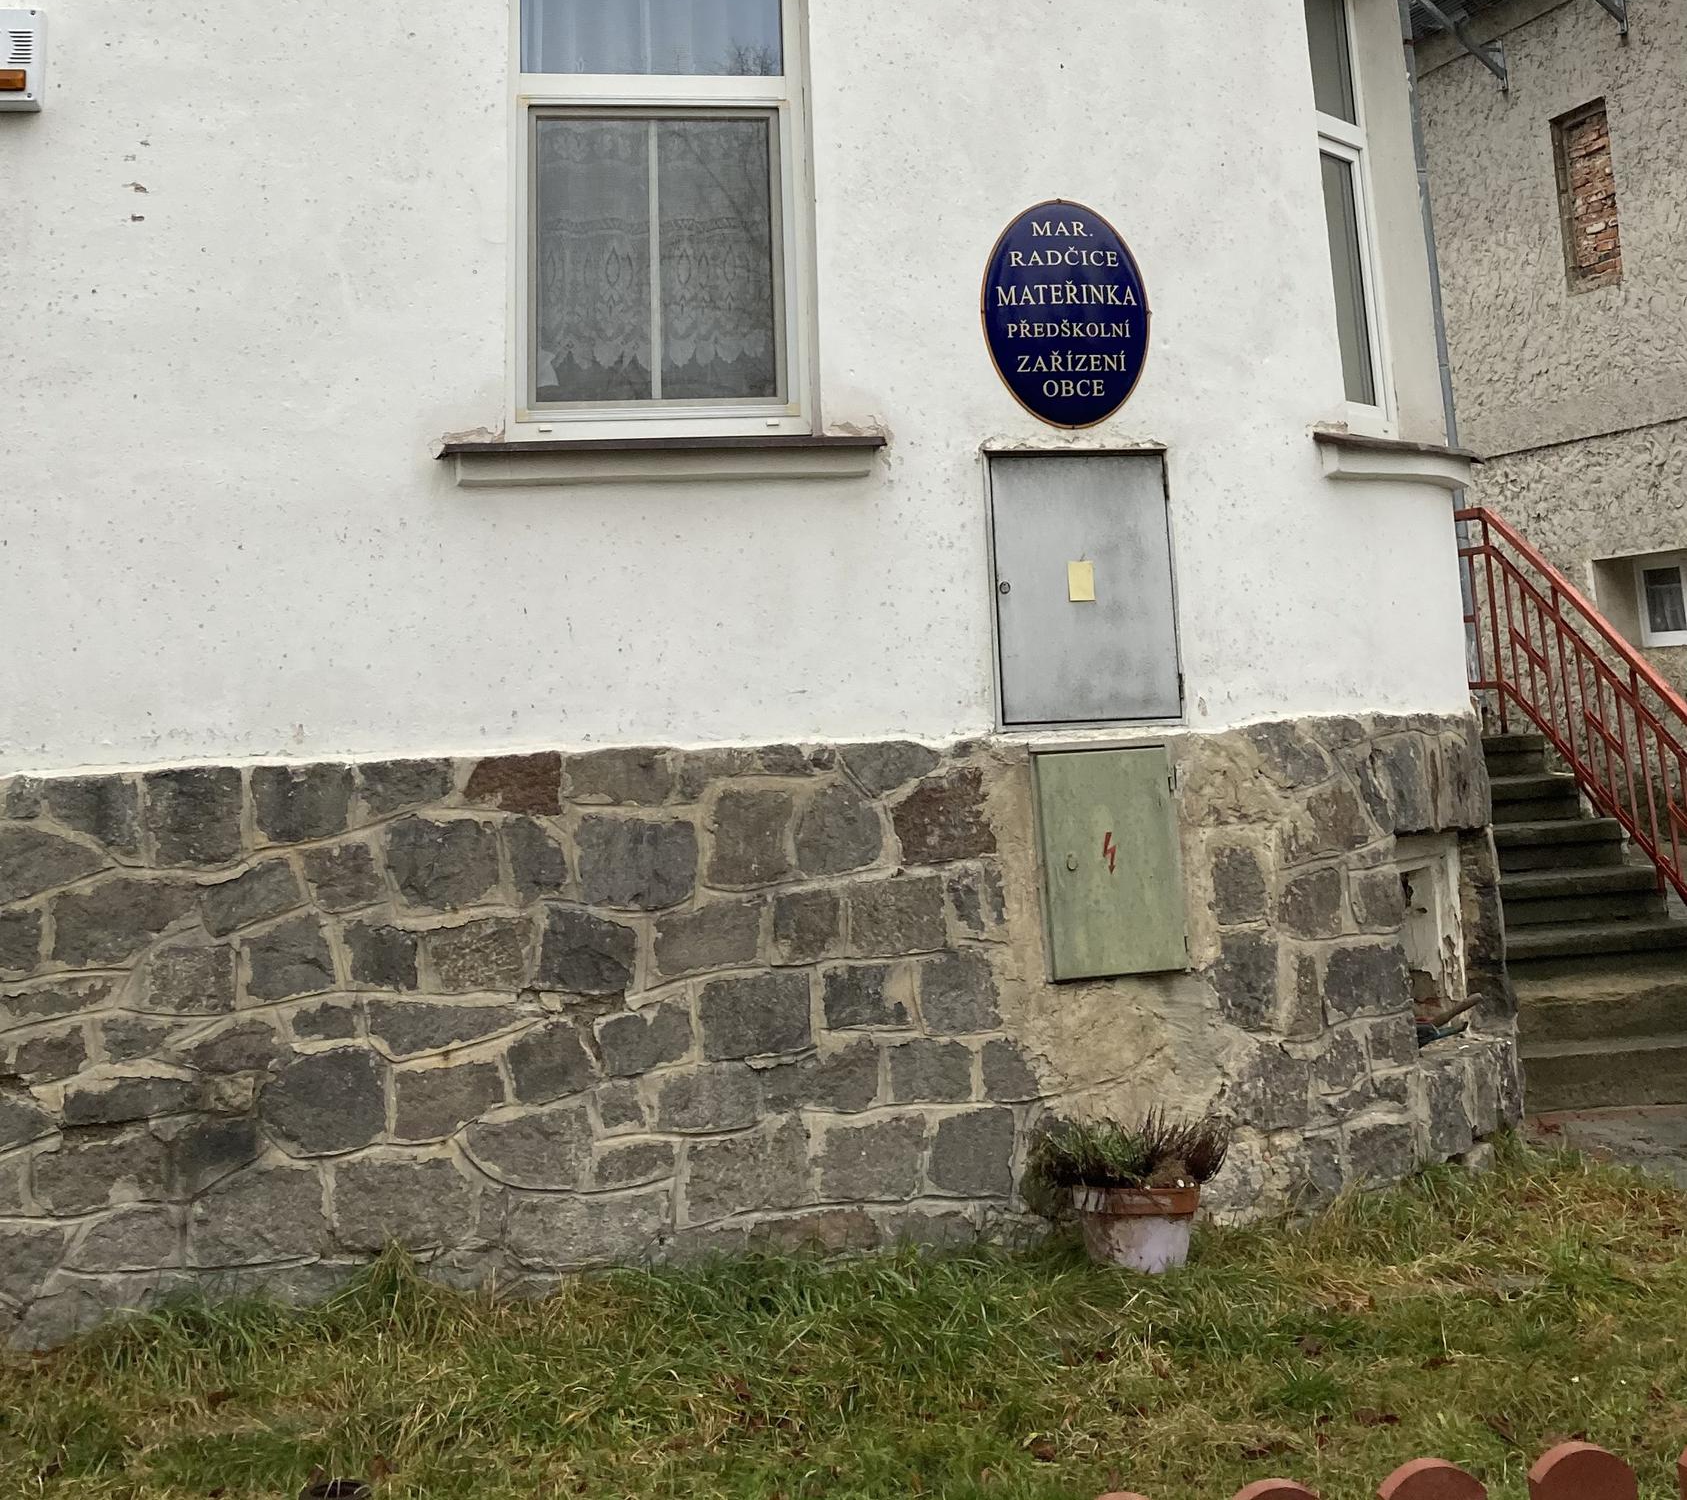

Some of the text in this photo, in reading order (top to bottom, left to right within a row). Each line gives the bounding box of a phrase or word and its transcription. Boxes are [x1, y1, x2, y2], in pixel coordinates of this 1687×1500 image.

[1032, 221, 1093, 237] MAR.
[1009, 246, 1119, 267] RADČICE
[996, 280, 1137, 307] MATEŘINKA
[1007, 319, 1131, 338] PŘEDŠKOLNÍ
[1017, 350, 1127, 372] ZAŘÍZENÍ
[1042, 379, 1105, 397] OBCE
